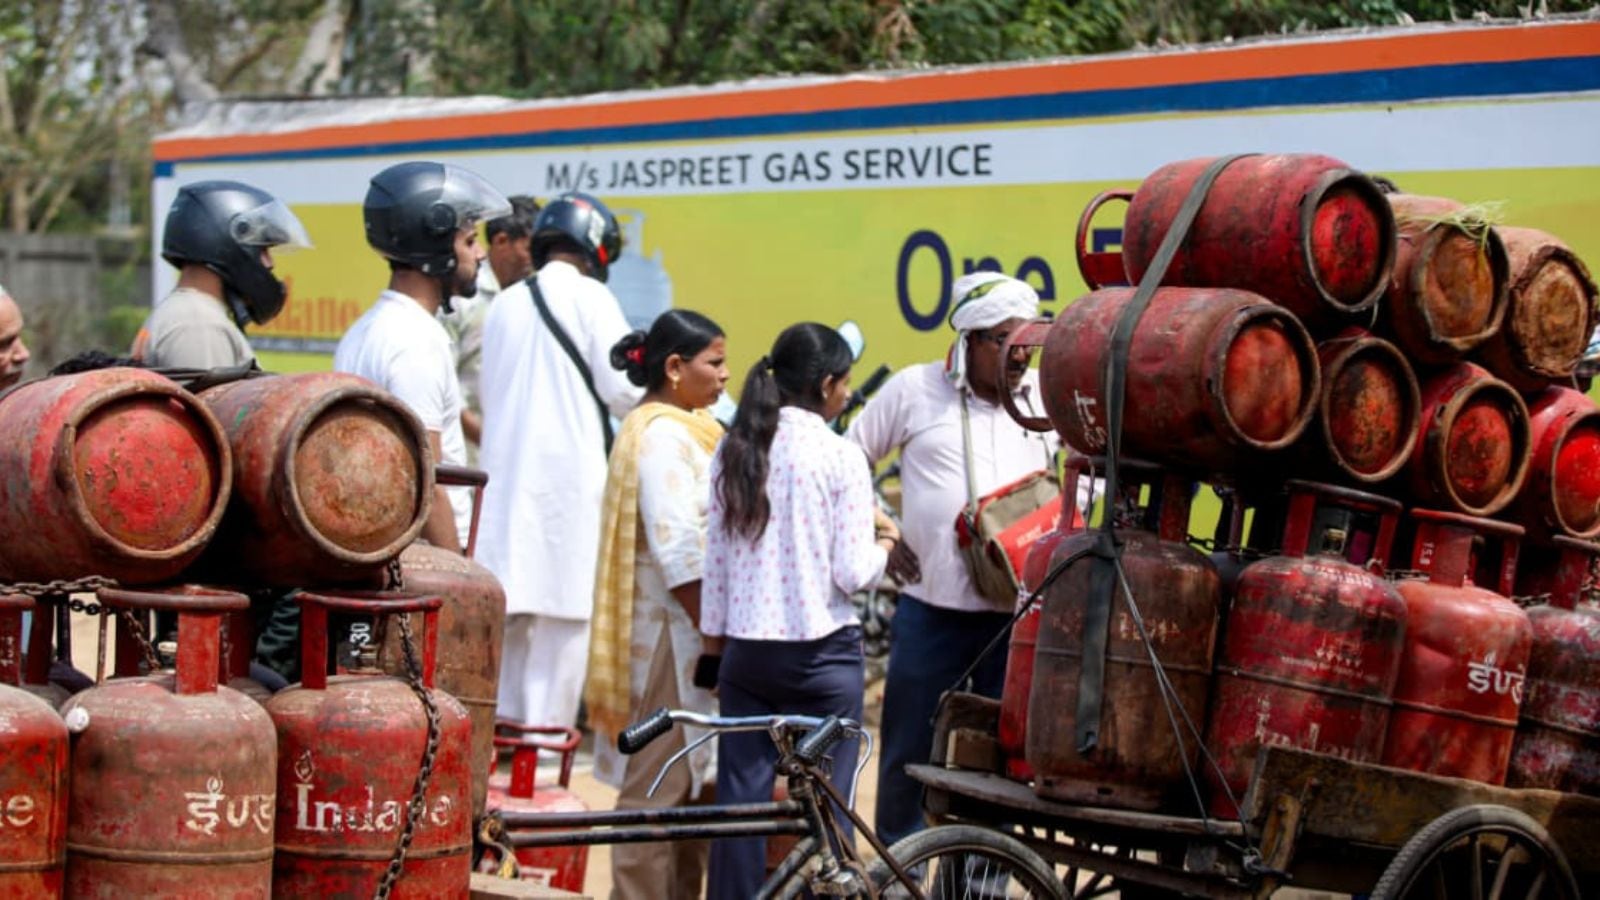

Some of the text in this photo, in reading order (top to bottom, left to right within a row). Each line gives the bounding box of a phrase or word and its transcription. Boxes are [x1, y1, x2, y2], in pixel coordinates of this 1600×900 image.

[546, 143, 992, 192] M/s JASPREET GAS SERVICE
[896, 229, 1056, 332] Oe
